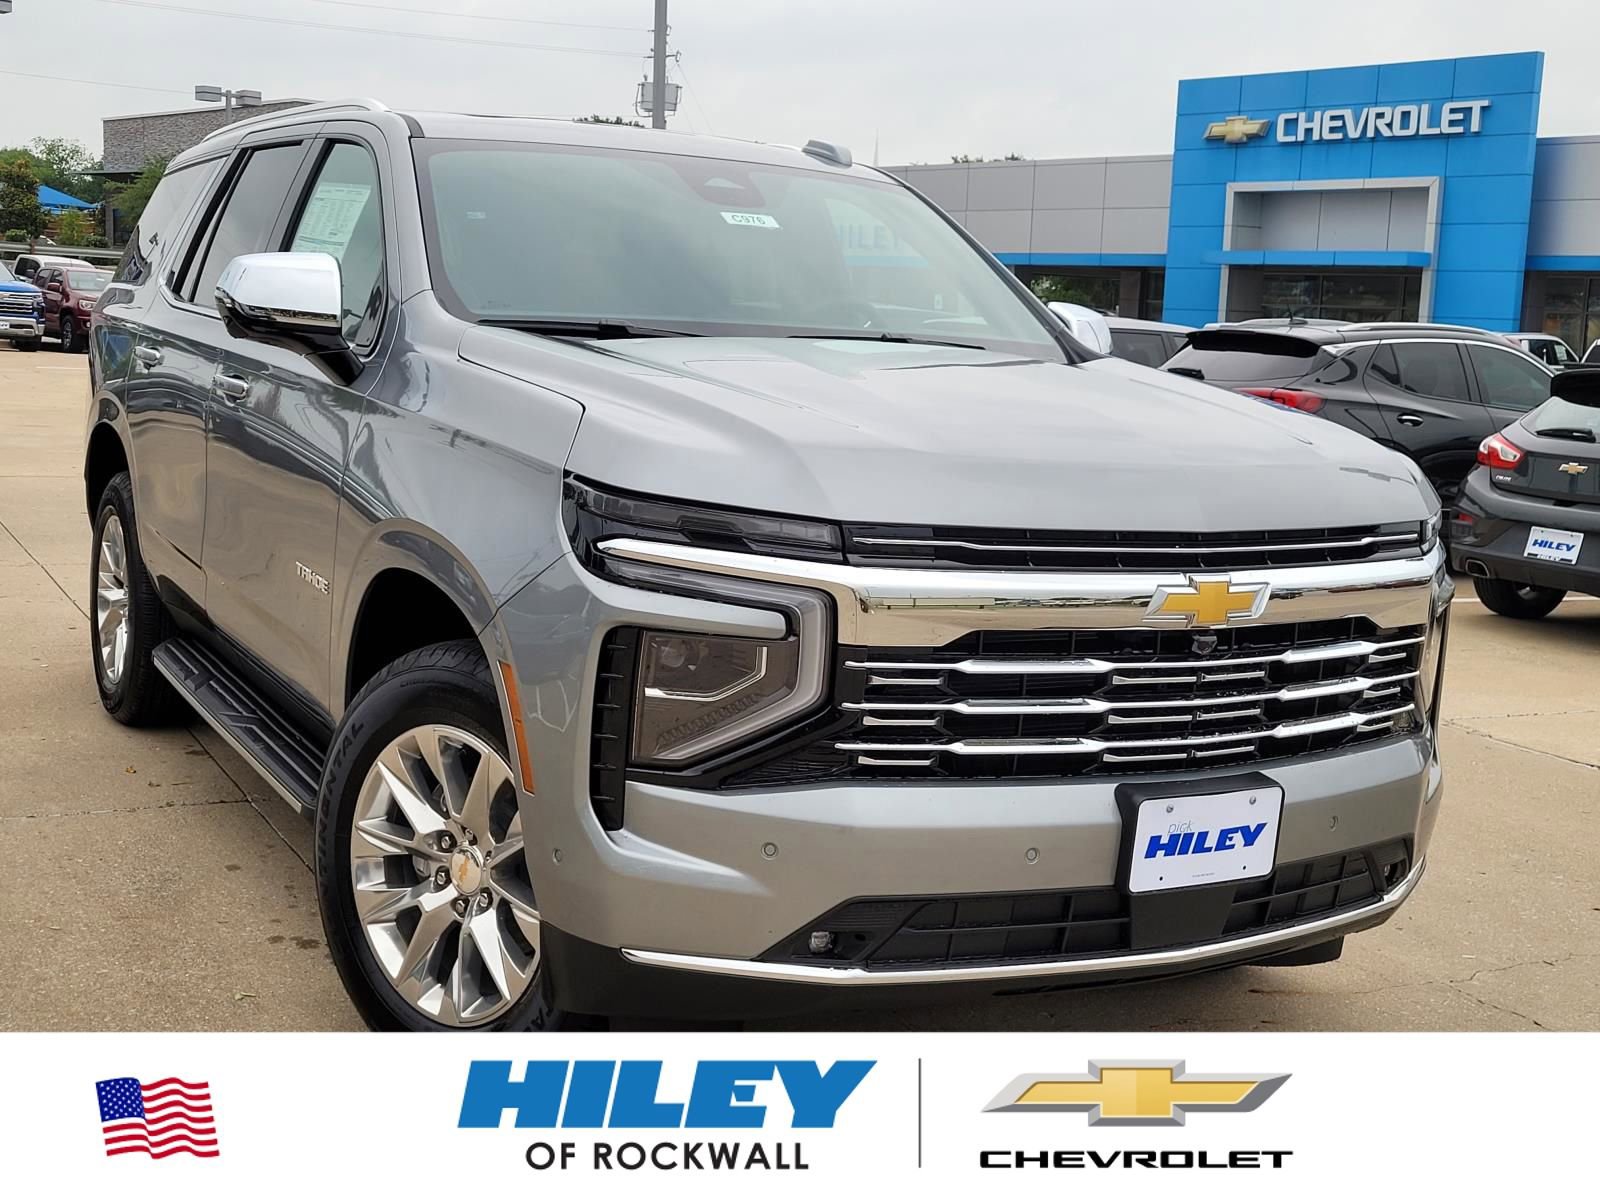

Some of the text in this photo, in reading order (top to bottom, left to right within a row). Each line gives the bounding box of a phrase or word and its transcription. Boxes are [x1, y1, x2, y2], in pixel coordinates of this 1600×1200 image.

[1276, 100, 1491, 143] CHEVROLET
[1531, 538, 1576, 552] HILEY
[295, 560, 330, 595] TAHOE
[1144, 822, 1268, 859] HILEY
